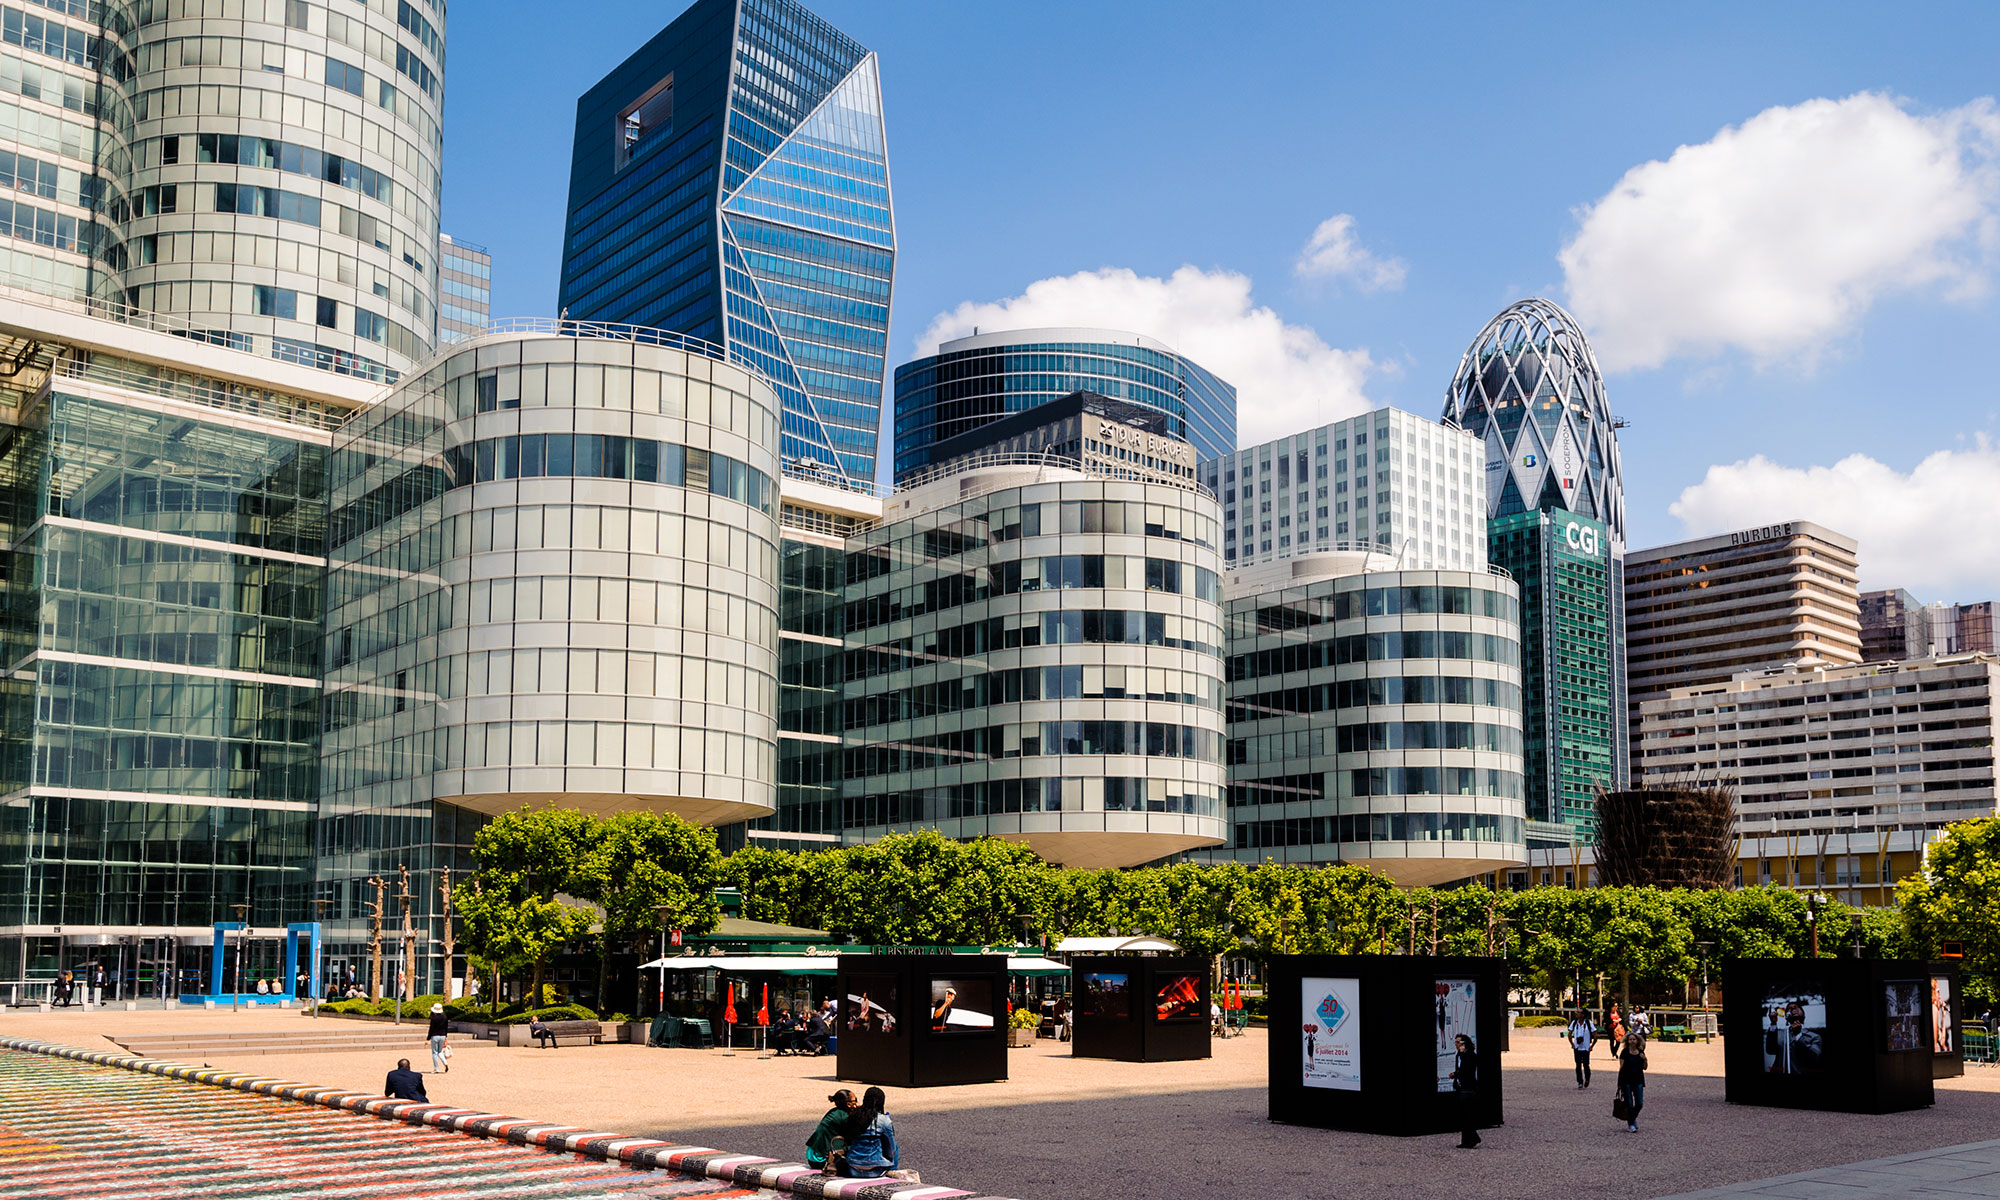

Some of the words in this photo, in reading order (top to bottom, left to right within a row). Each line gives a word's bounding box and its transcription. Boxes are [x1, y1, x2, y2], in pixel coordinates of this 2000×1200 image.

[1114, 426, 1141, 447] TOUR
[1148, 435, 1189, 459] EUROPE
[1563, 425, 1571, 475] SOGEPROM
[1566, 521, 1598, 556] CGI
[1731, 523, 1791, 545] AURORE
[888, 946, 925, 955] BISTROT
[938, 947, 954, 955] VIN
[1322, 999, 1338, 1012] 50
